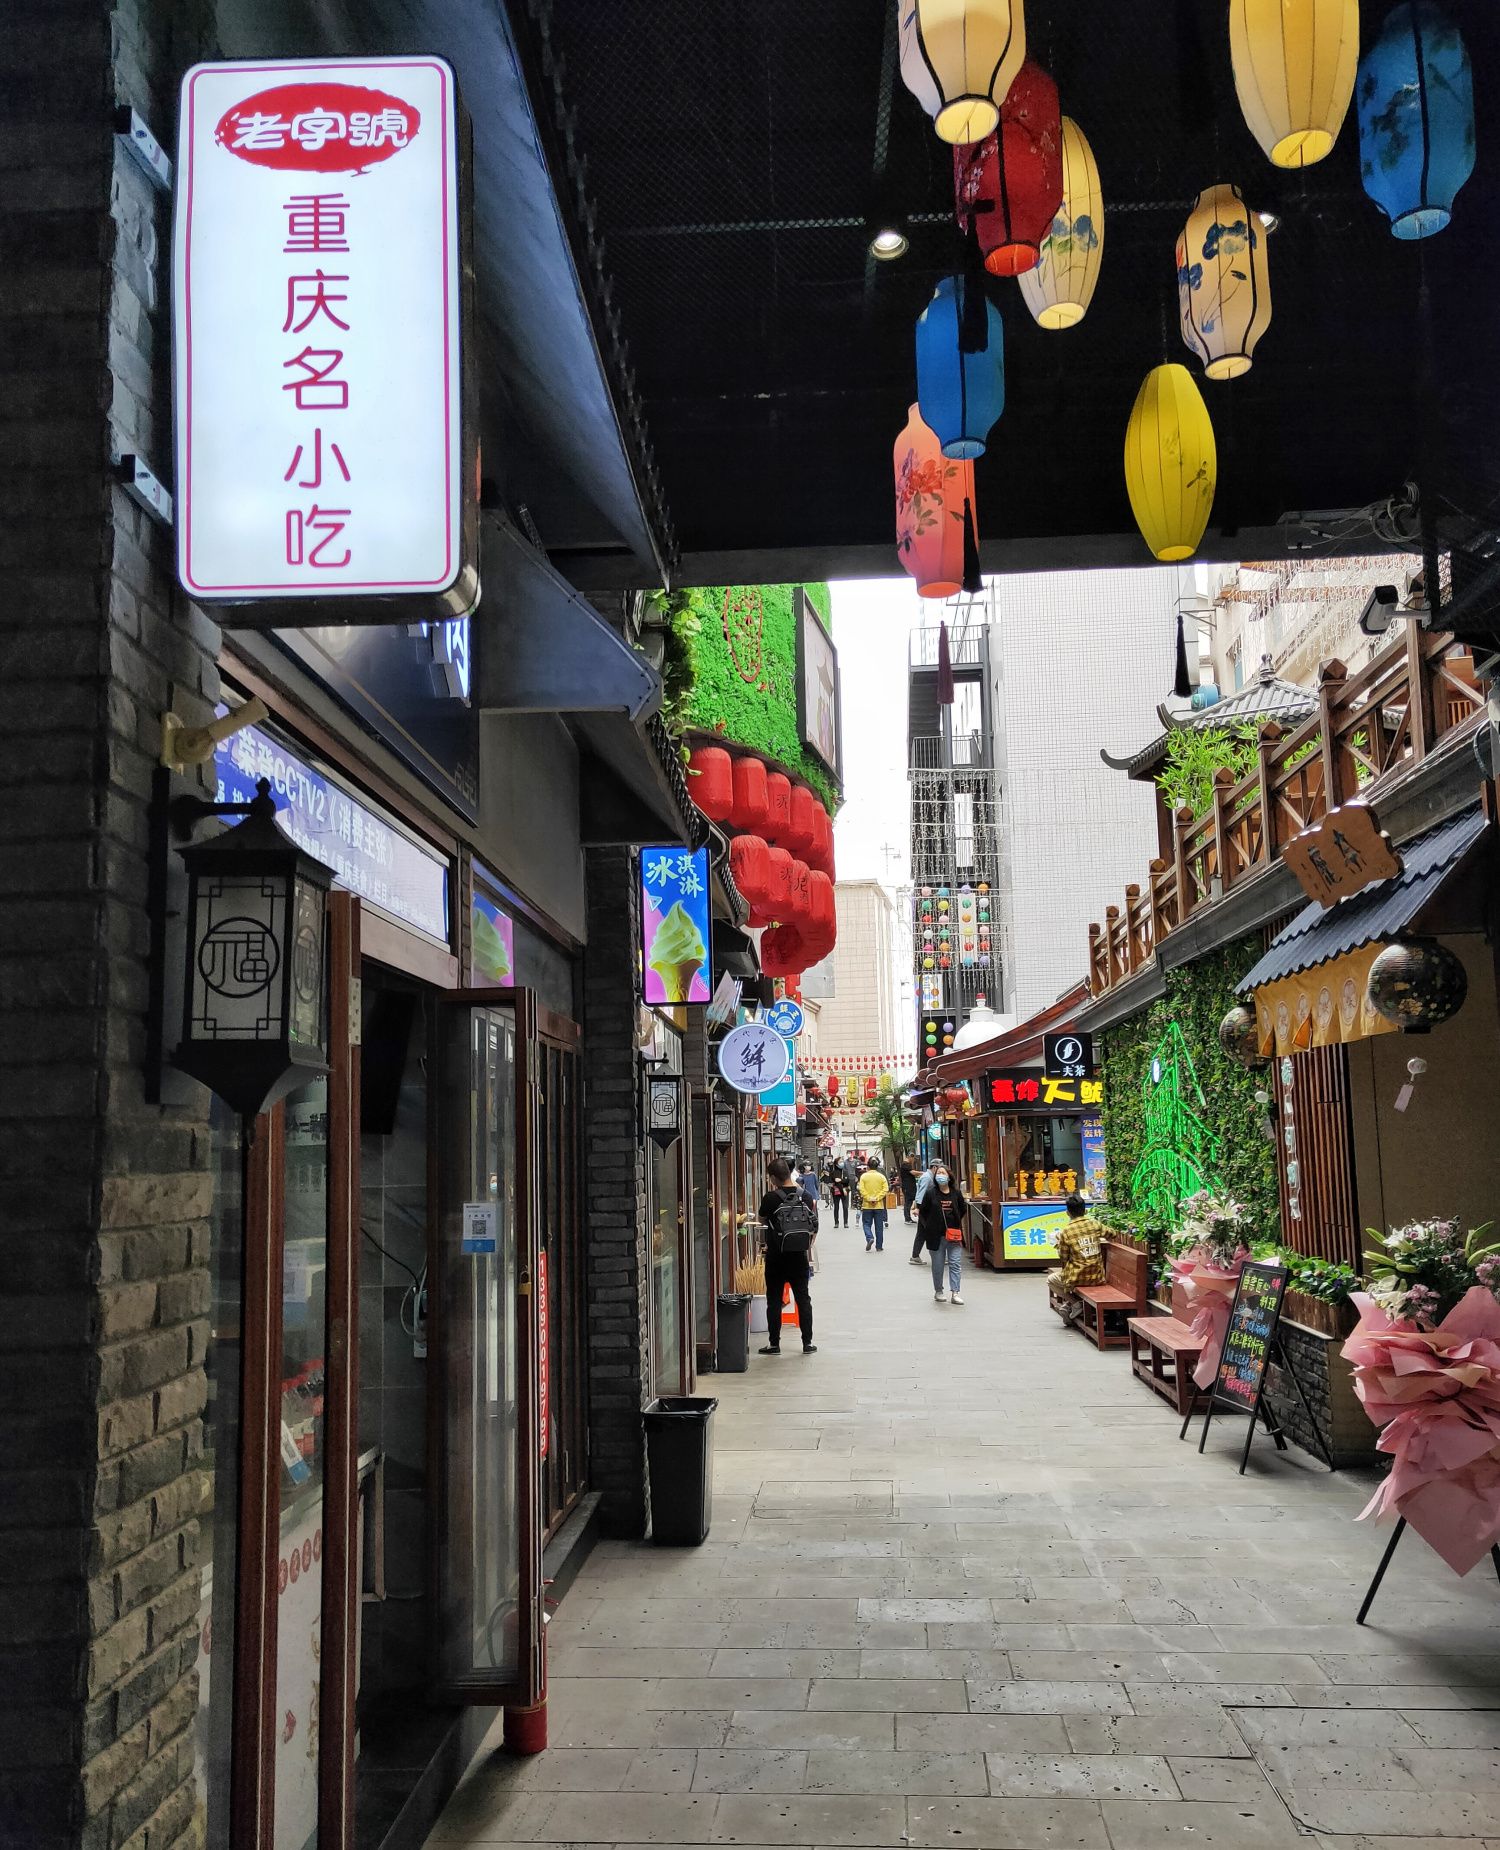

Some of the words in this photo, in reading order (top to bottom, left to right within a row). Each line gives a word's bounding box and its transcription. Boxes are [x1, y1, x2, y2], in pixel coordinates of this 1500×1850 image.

[231, 107, 408, 151] 老字號
[282, 192, 351, 568] 重庆名小吃
[646, 855, 704, 898] 冰淇淋
[1050, 1064, 1086, 1077] 一夫茶
[1009, 1228, 1061, 1246] 轰炸
